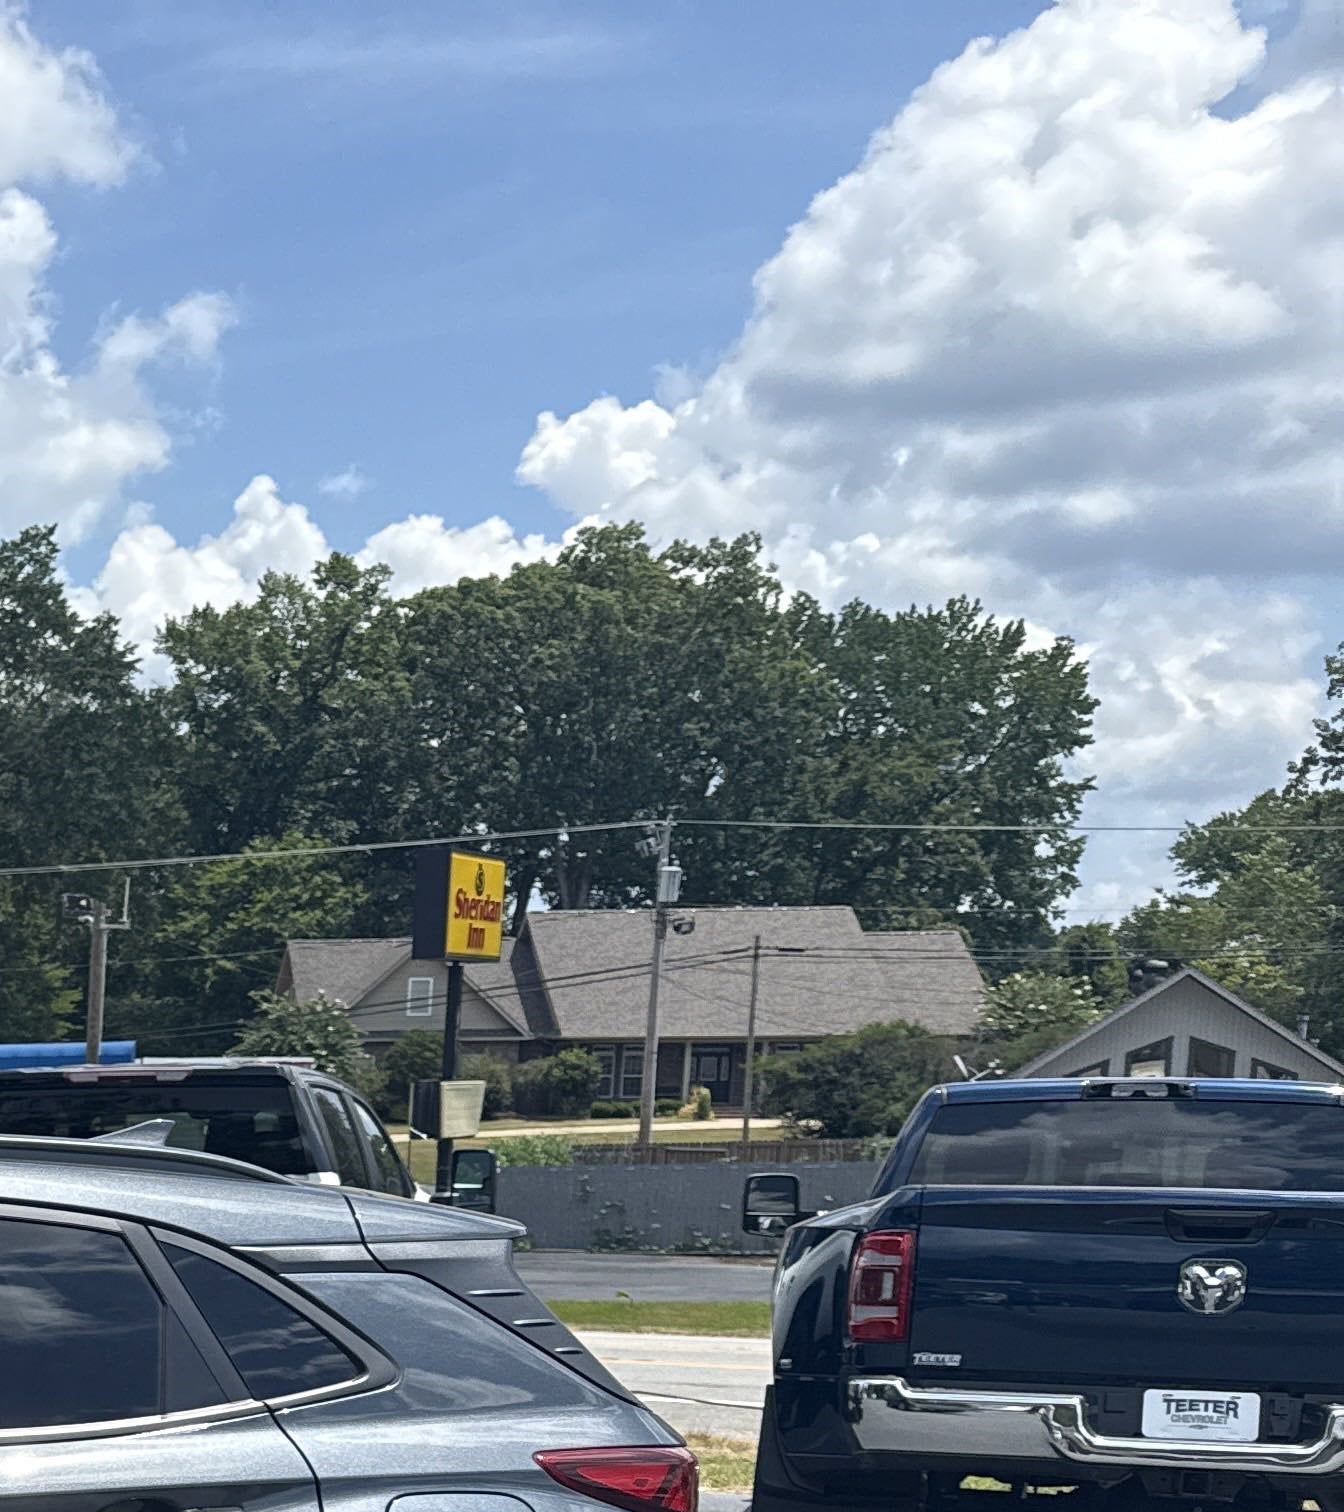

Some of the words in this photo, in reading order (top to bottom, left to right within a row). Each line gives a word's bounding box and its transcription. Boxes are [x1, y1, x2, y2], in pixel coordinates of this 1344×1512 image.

[454, 887, 501, 922] Sheridan
[466, 922, 486, 950] Inn
[1162, 1398, 1239, 1419] TEETER
[1170, 1413, 1230, 1425] CHEVROLET
